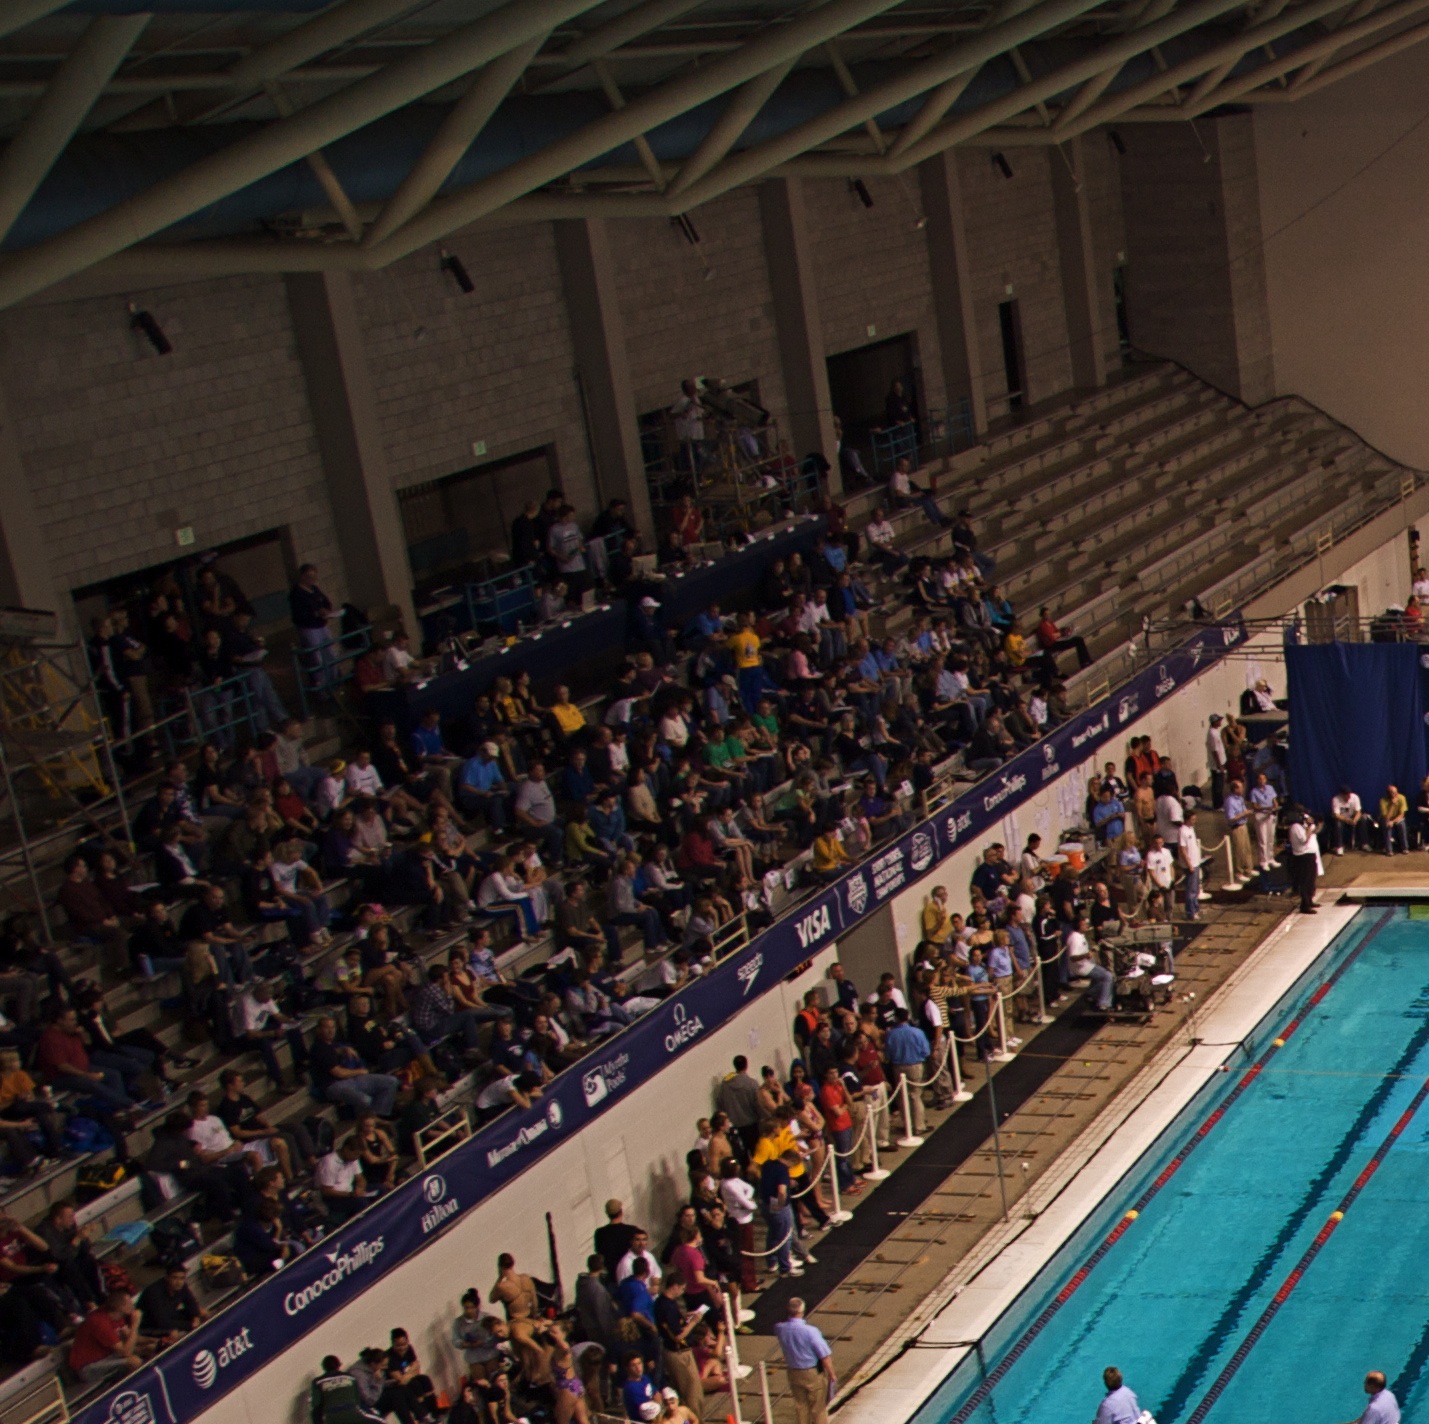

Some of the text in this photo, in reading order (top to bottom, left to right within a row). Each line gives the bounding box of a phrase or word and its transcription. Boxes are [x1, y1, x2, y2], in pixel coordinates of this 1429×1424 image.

[795, 905, 832, 948] VISA
[665, 1016, 704, 1053] OMEGA
[421, 1198, 458, 1233] Hilton
[284, 1236, 385, 1316] ConocoPhillips
[218, 1327, 255, 1368] at&t
